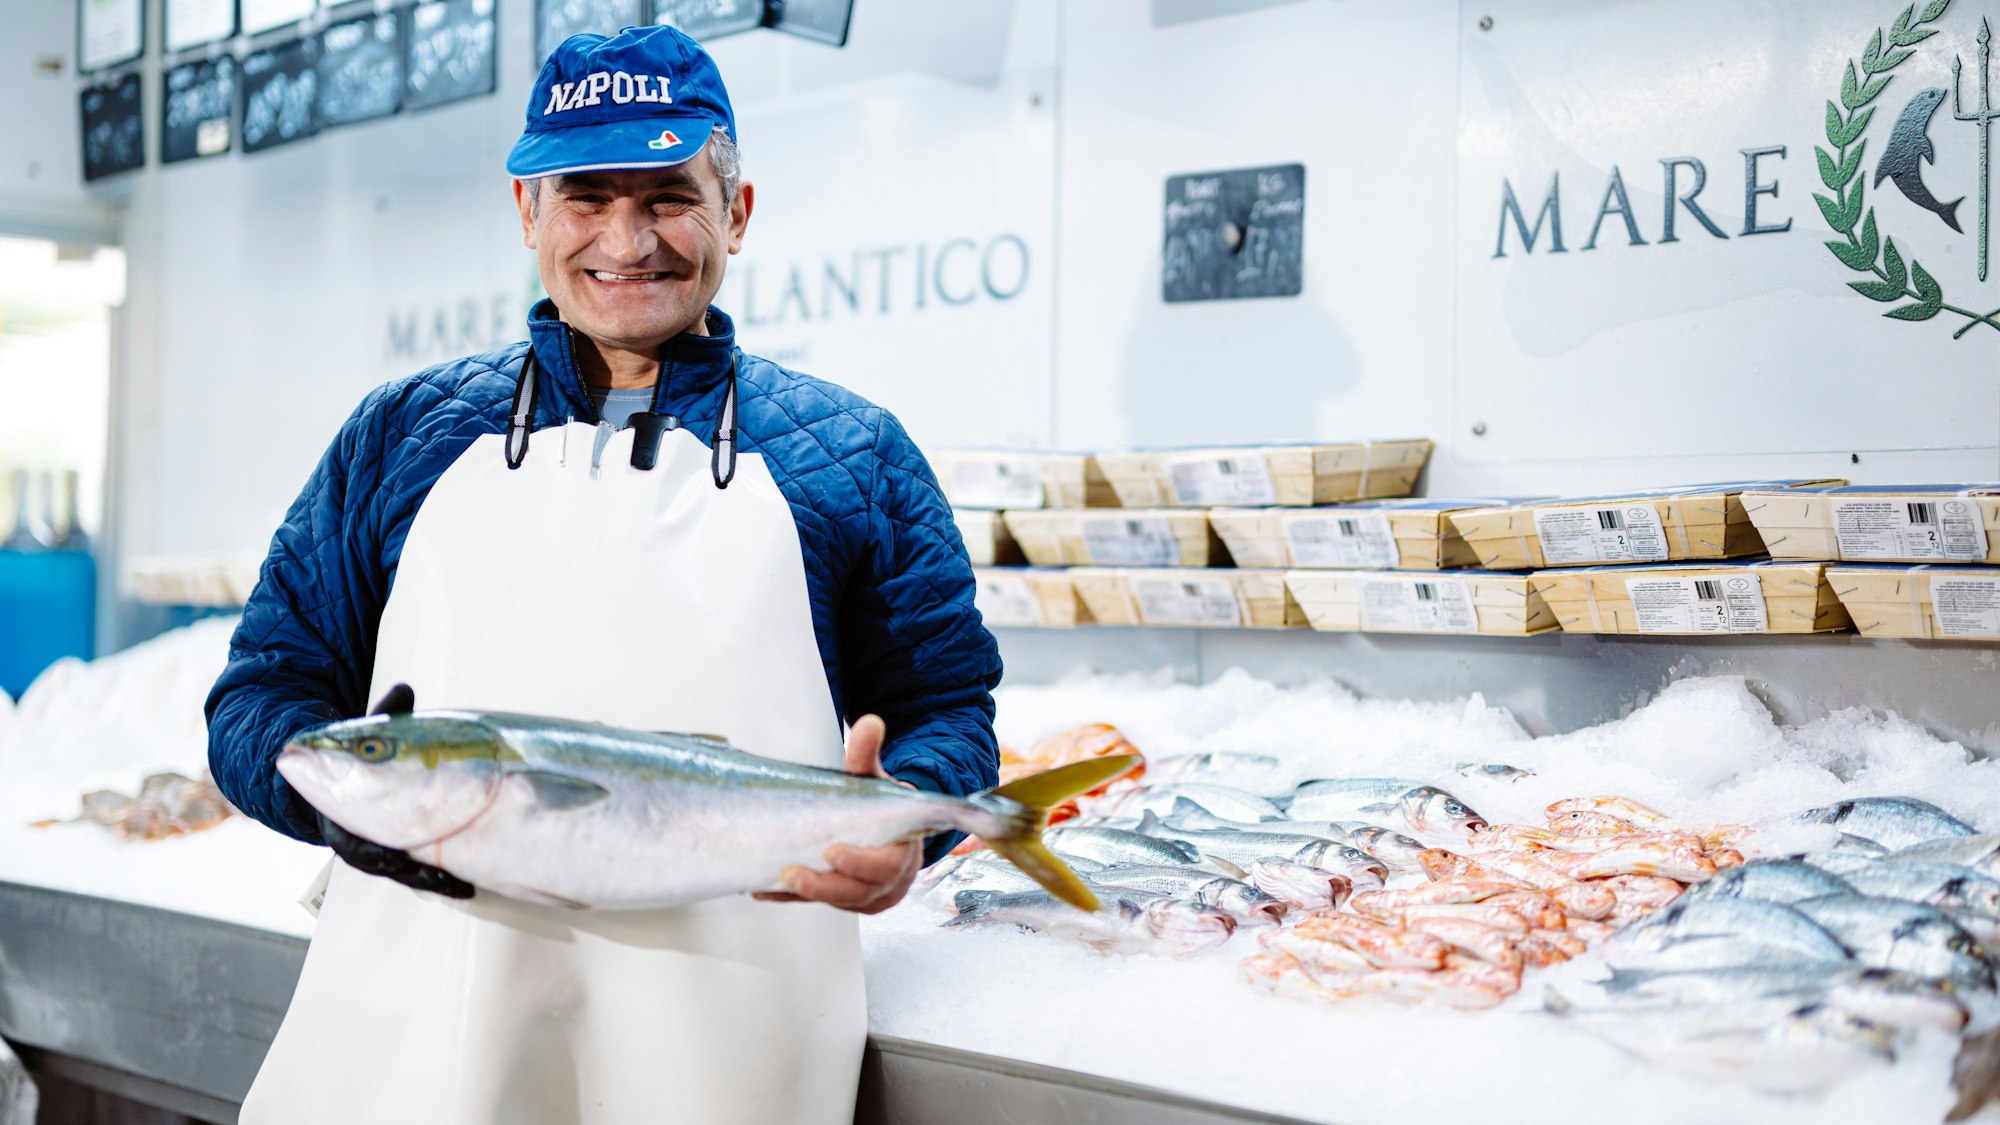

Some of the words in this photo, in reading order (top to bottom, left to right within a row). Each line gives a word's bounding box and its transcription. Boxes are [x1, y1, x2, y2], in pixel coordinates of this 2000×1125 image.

[543, 71, 673, 117] NAPOLI
[1491, 144, 1794, 260] MARE
[384, 290, 513, 367] MARE
[1617, 535, 1625, 545] 2
[1928, 531, 1936, 541] 2
[1716, 605, 1724, 615] 2
[1719, 616, 1727, 624] 12
